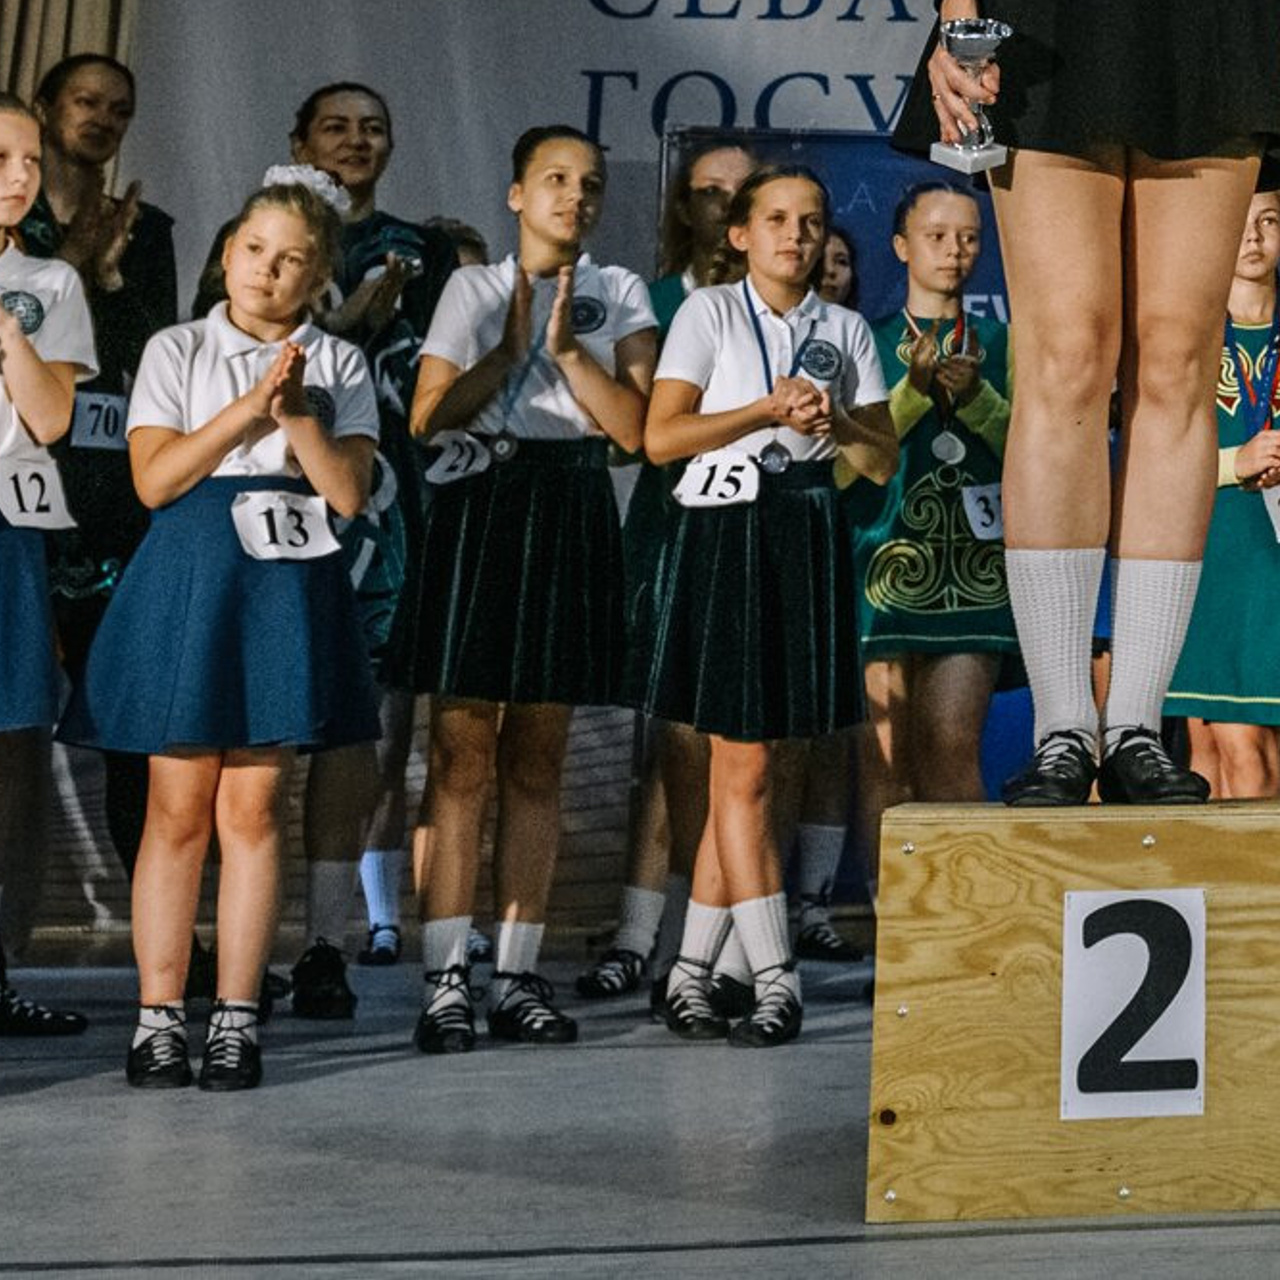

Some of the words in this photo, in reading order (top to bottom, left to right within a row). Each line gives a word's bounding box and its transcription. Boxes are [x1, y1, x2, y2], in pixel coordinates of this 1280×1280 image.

[87, 404, 119, 438] 70
[9, 472, 51, 513] 12
[698, 463, 745, 500] 15
[258, 506, 310, 548] 13
[976, 494, 1002, 529] 3
[1076, 898, 1199, 1094] 2
